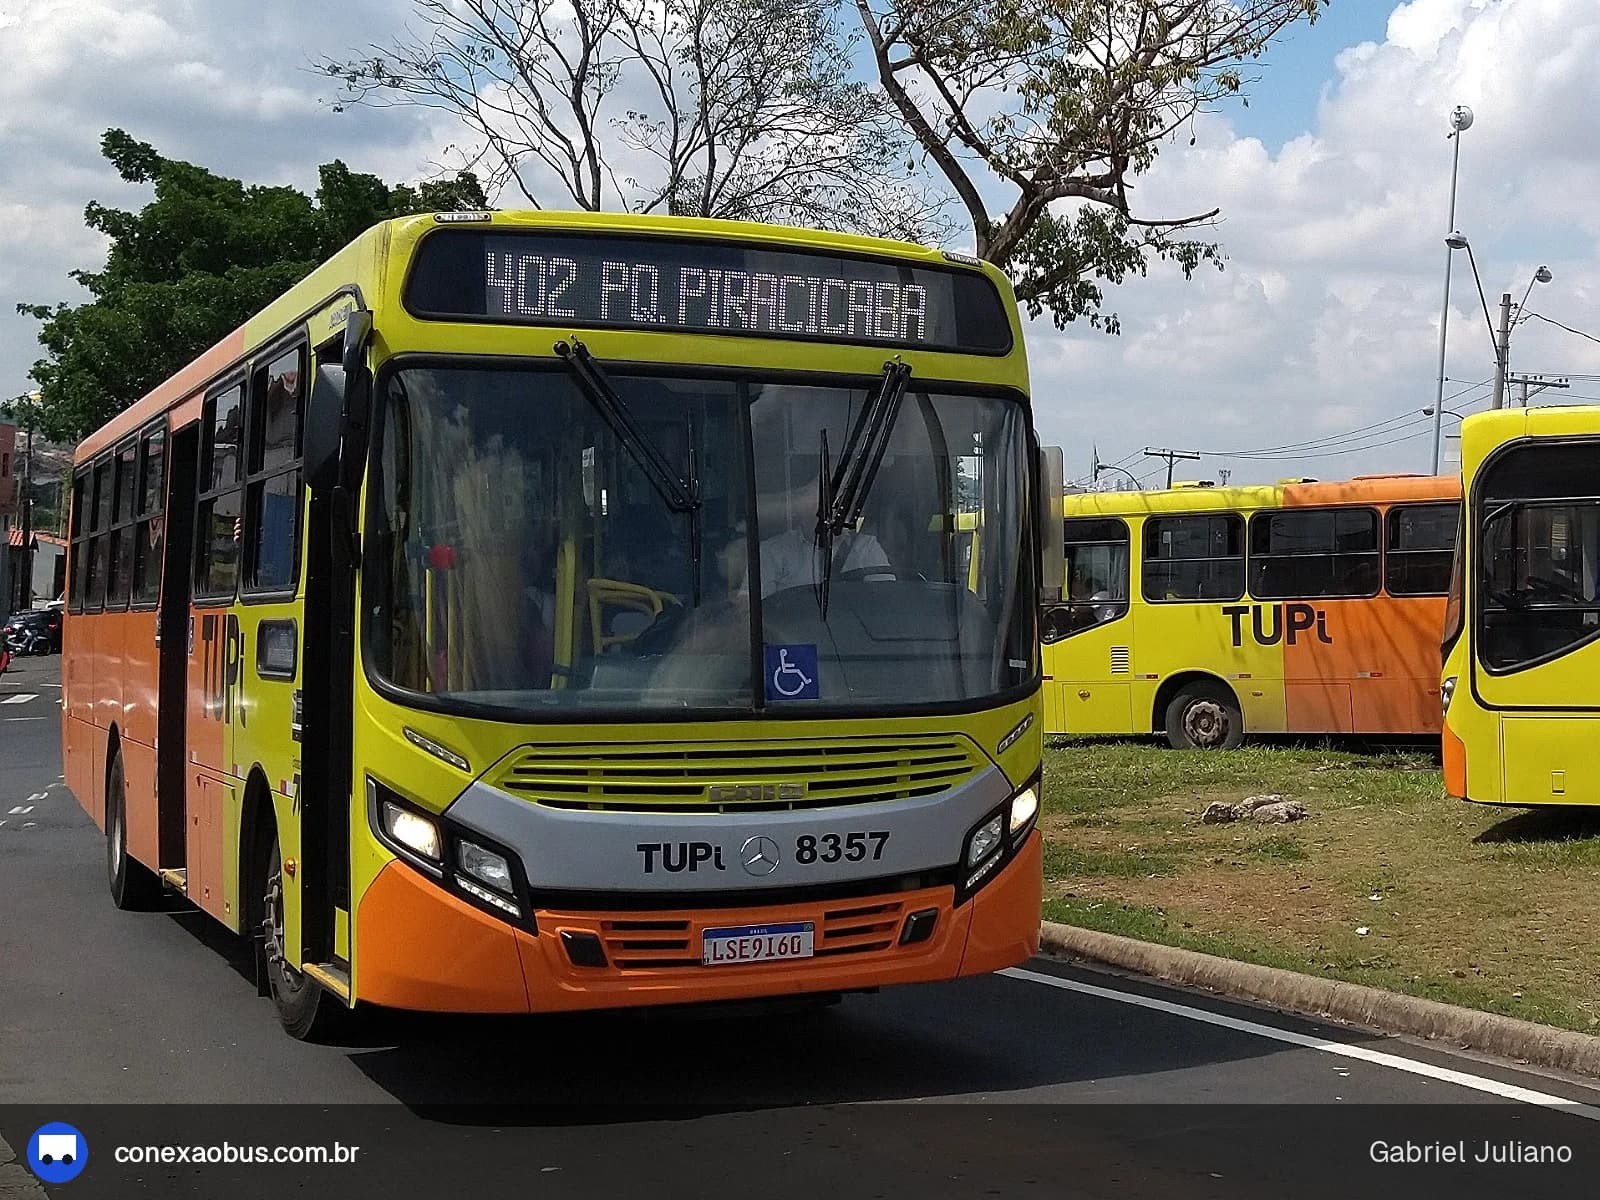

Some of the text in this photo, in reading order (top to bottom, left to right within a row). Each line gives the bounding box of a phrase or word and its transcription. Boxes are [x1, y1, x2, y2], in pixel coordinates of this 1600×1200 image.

[487, 252, 927, 340] 402 PQ. PIRACICABA
[1222, 603, 1333, 647] TUPi
[636, 831, 890, 874] TUPi 8357
